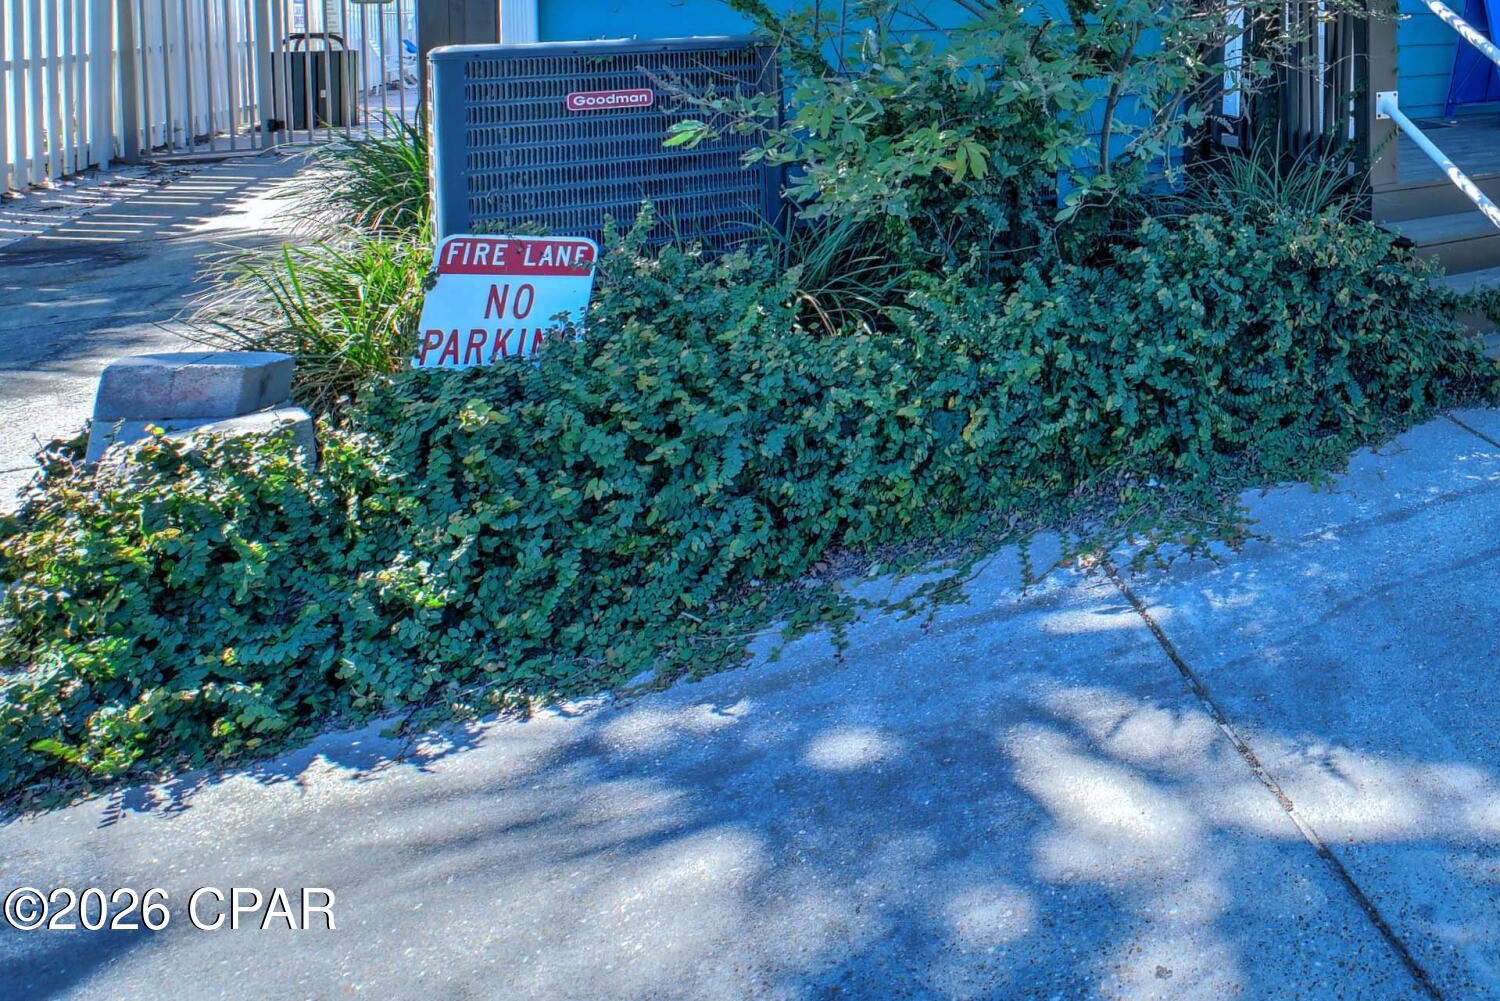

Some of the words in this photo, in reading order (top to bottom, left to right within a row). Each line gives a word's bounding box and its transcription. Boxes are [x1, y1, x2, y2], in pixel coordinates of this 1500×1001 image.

[572, 90, 648, 106] Goodman
[446, 242, 508, 266] FIRE
[484, 283, 535, 320] NO
[418, 328, 566, 366] PARKIN
